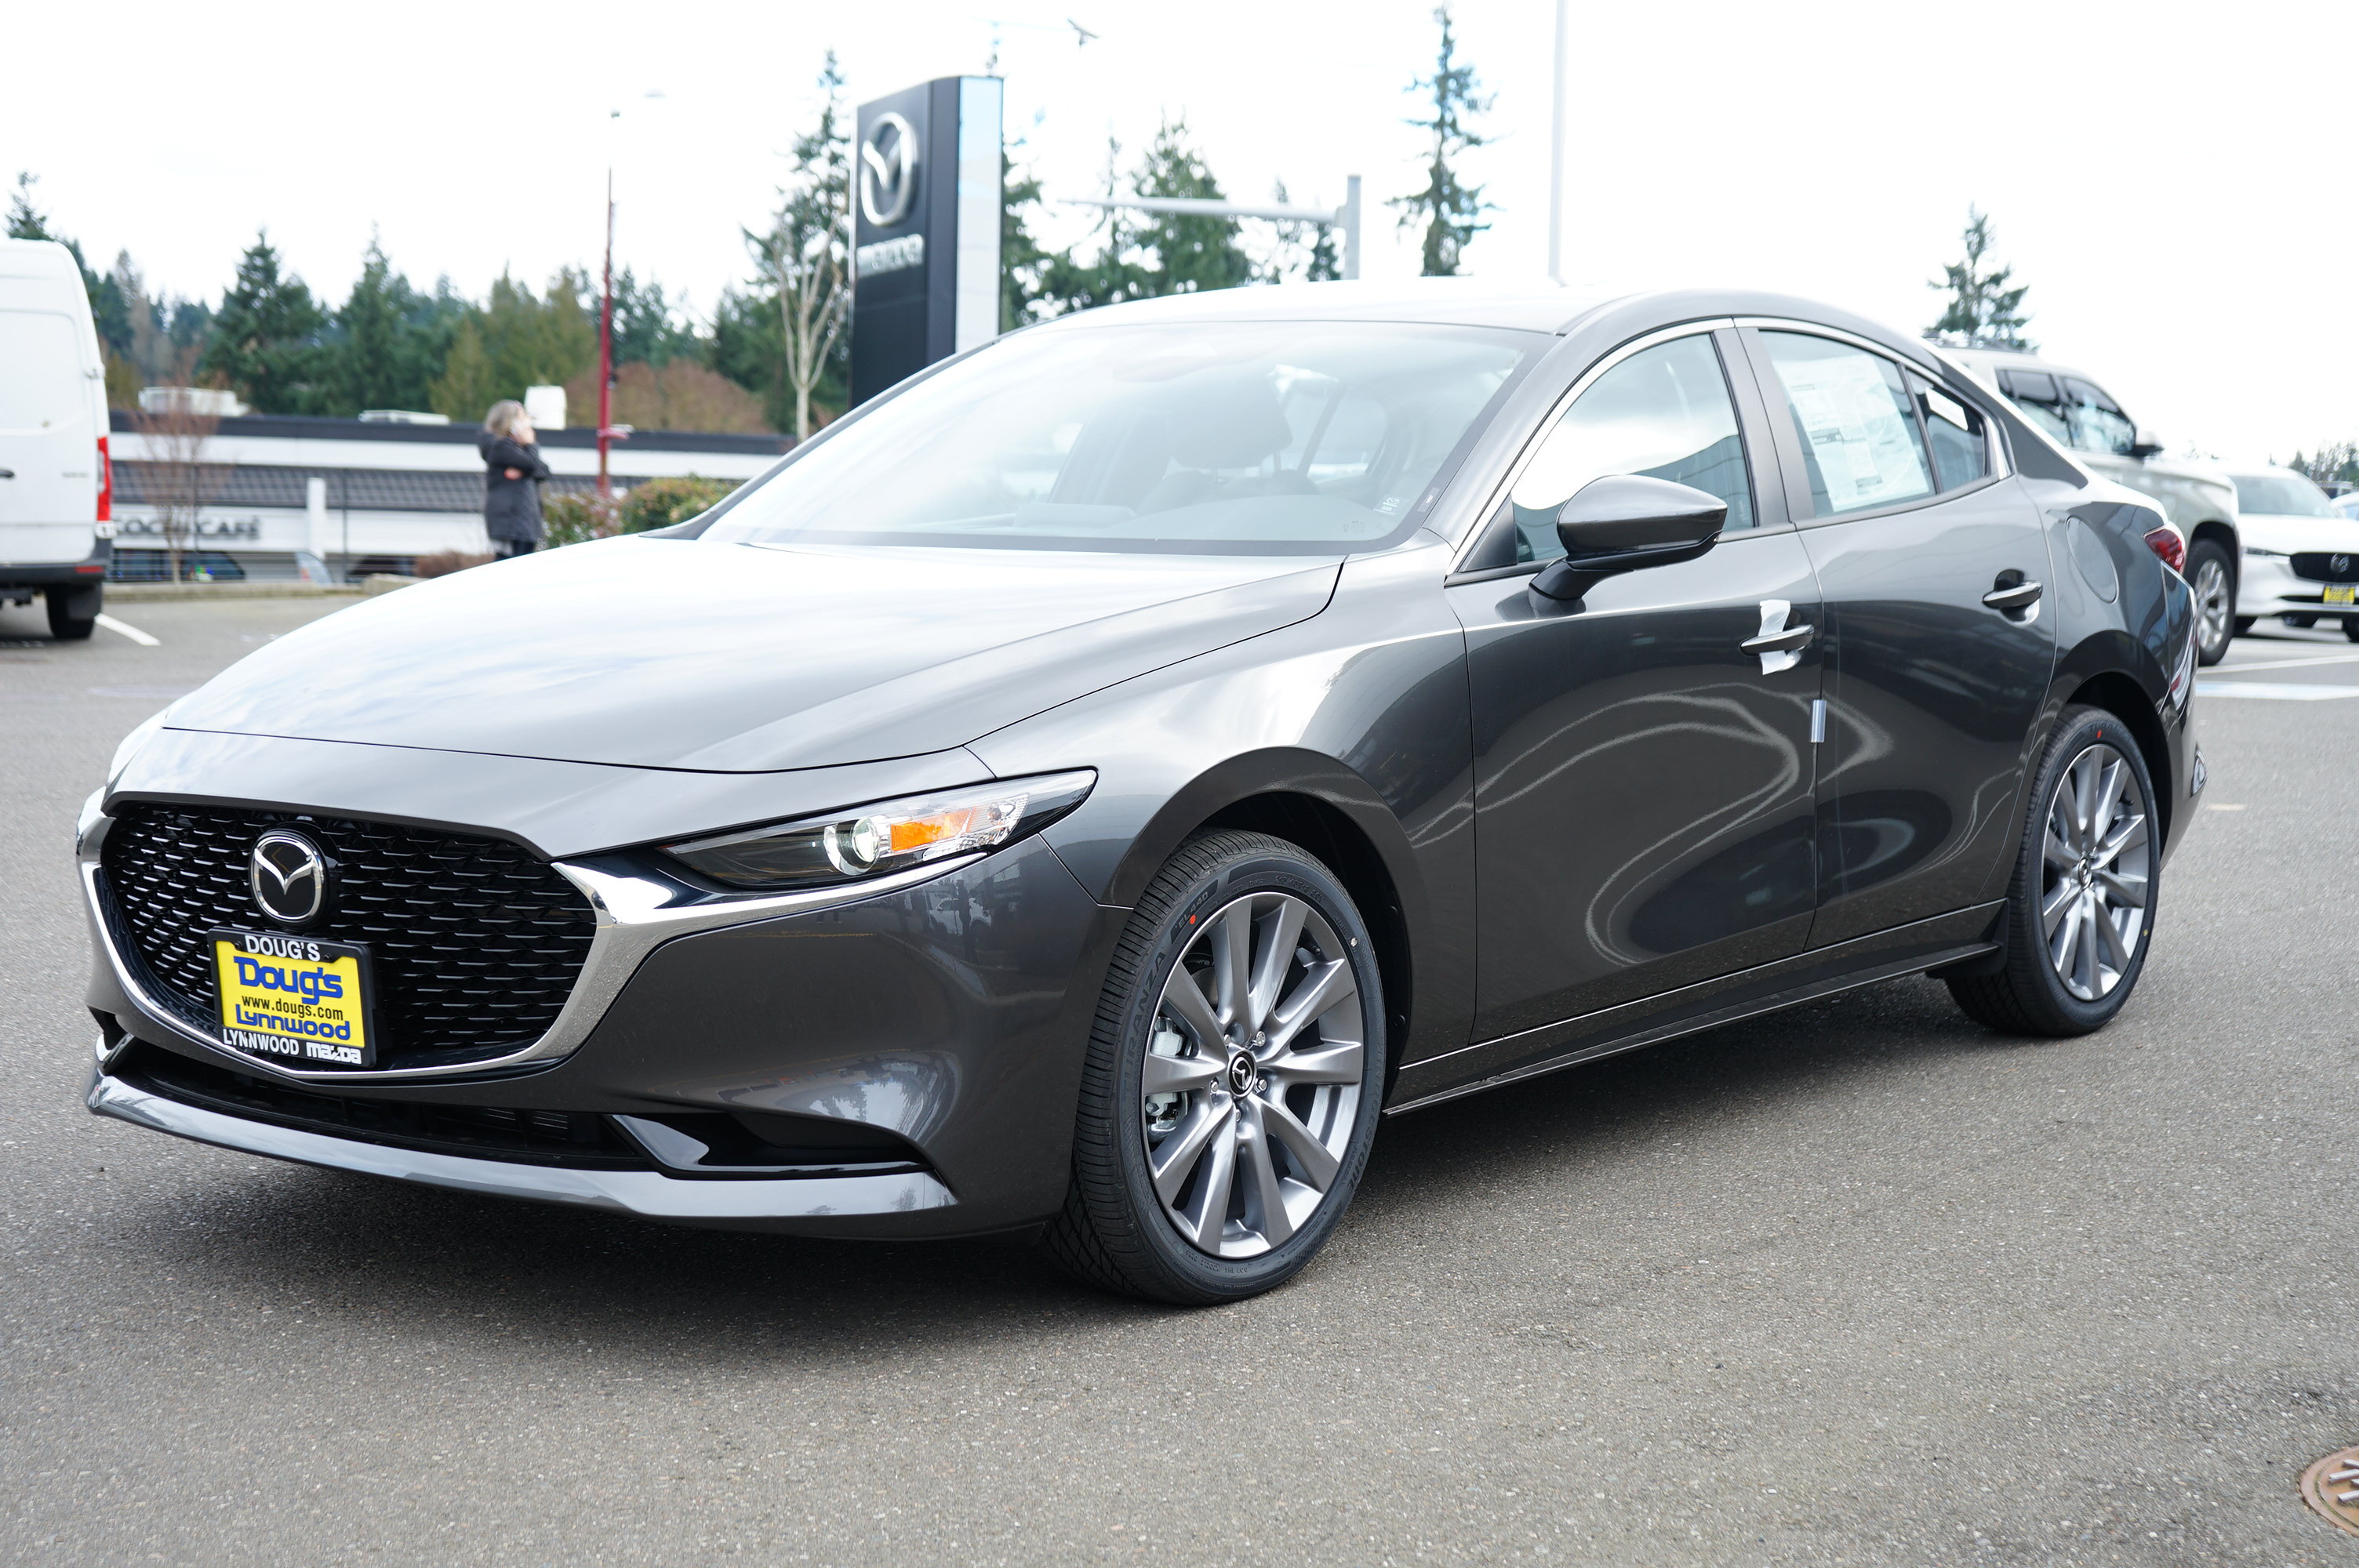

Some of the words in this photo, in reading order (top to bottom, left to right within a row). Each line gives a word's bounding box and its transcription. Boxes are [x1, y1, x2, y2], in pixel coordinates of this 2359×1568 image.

[1178, 891, 1209, 930] EL440
[245, 935, 321, 961] DOUG'S
[235, 1004, 350, 1040] Lynnwood
[242, 996, 343, 1020] www.dougs.com
[1122, 950, 1166, 1098] TURANZA
[223, 1029, 299, 1054] LYNNWOOD
